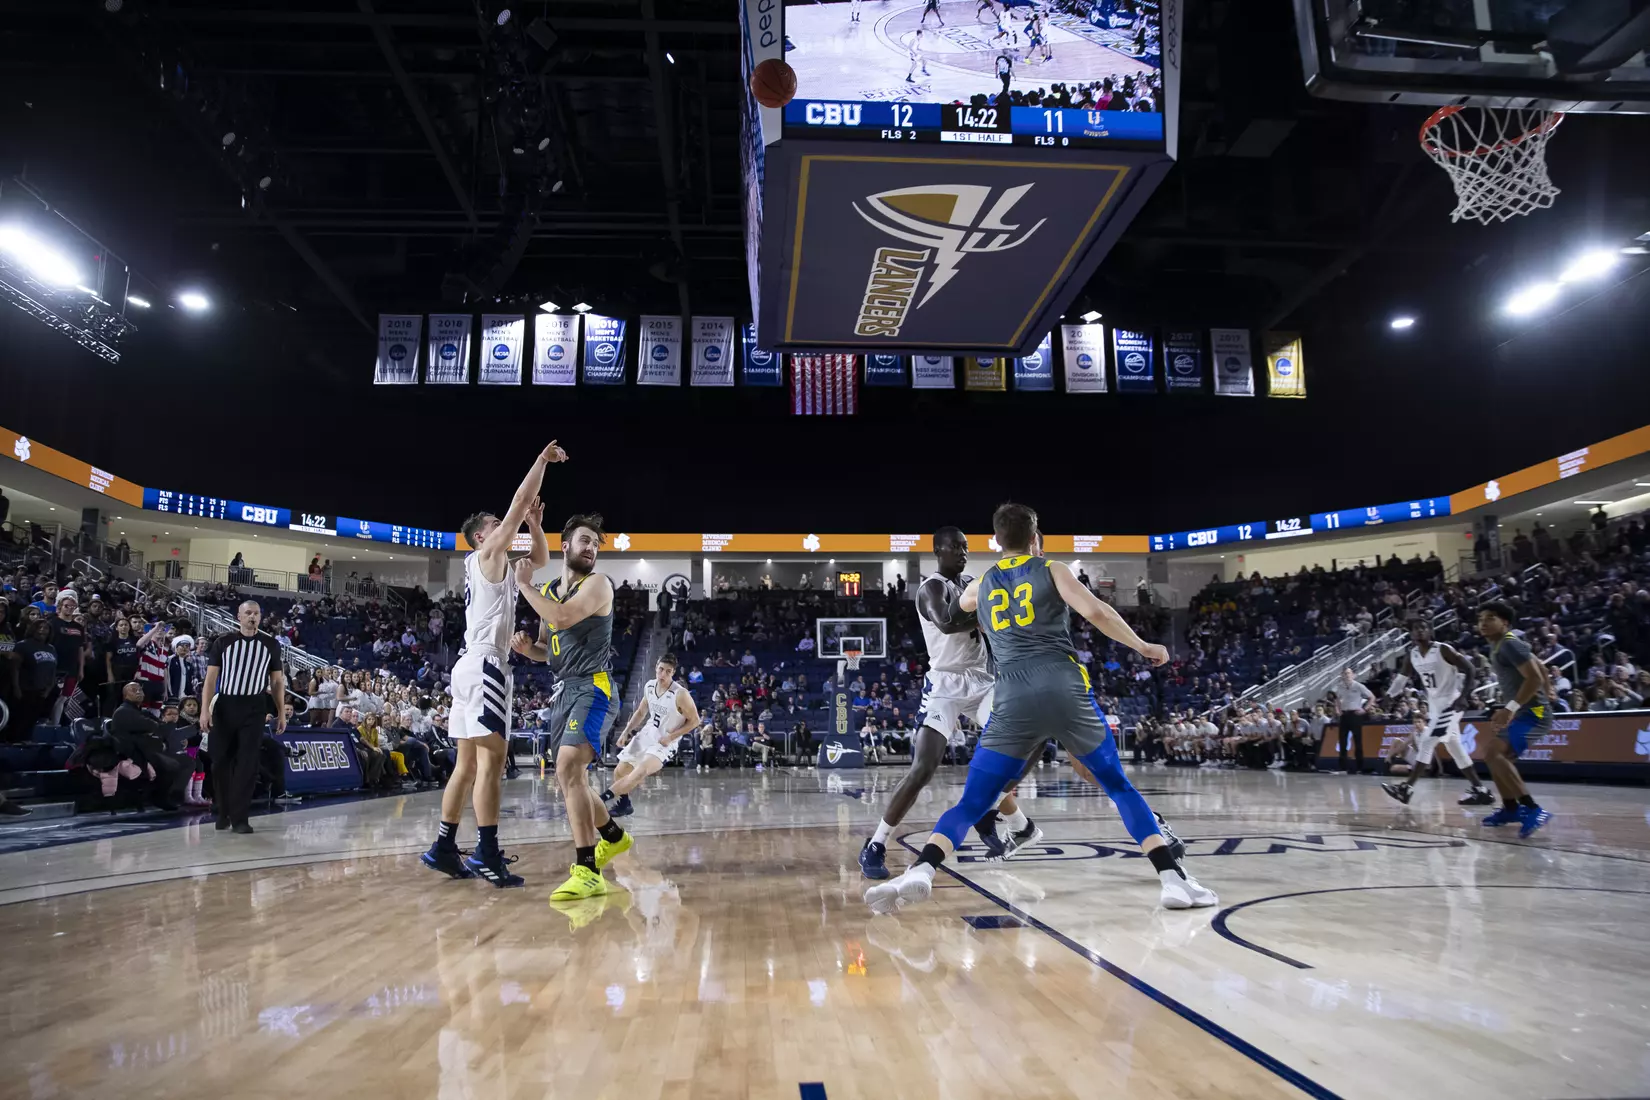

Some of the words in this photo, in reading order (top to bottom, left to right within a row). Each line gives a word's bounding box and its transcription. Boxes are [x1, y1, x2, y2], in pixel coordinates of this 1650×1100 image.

[806, 103, 862, 126] CBU
[891, 104, 913, 127] 12
[956, 108, 999, 129] 14:22
[1044, 110, 1064, 133] 11
[881, 129, 902, 139] FLS
[910, 131, 917, 140] 2
[952, 133, 972, 141] 1ST
[978, 134, 1003, 143] HALF
[1034, 136, 1055, 146] FLS
[1062, 137, 1069, 146] 0
[854, 247, 931, 337] LANCERS
[387, 320, 412, 328] 2018
[437, 320, 463, 328] 2018
[491, 320, 513, 328] 2017
[593, 320, 618, 329] 2016
[649, 321, 673, 329] 2015
[700, 322, 724, 330] 2014
[1121, 331, 1144, 339] 2017
[159, 490, 173, 499] PLYR
[241, 505, 278, 525] CBU
[301, 513, 326, 528] 14:22
[1325, 513, 1340, 529] 11
[1237, 525, 1252, 540] 12
[1275, 518, 1301, 532] 14:22
[1187, 530, 1218, 547] CBU
[841, 573, 860, 582] 14:22
[845, 582, 858, 596] 11
[989, 583, 1036, 632] 23
[551, 634, 561, 657] 0
[1422, 672, 1437, 689] 31
[653, 712, 661, 728] 5
[835, 692, 848, 735] CBU
[283, 740, 351, 772] LANCERS
